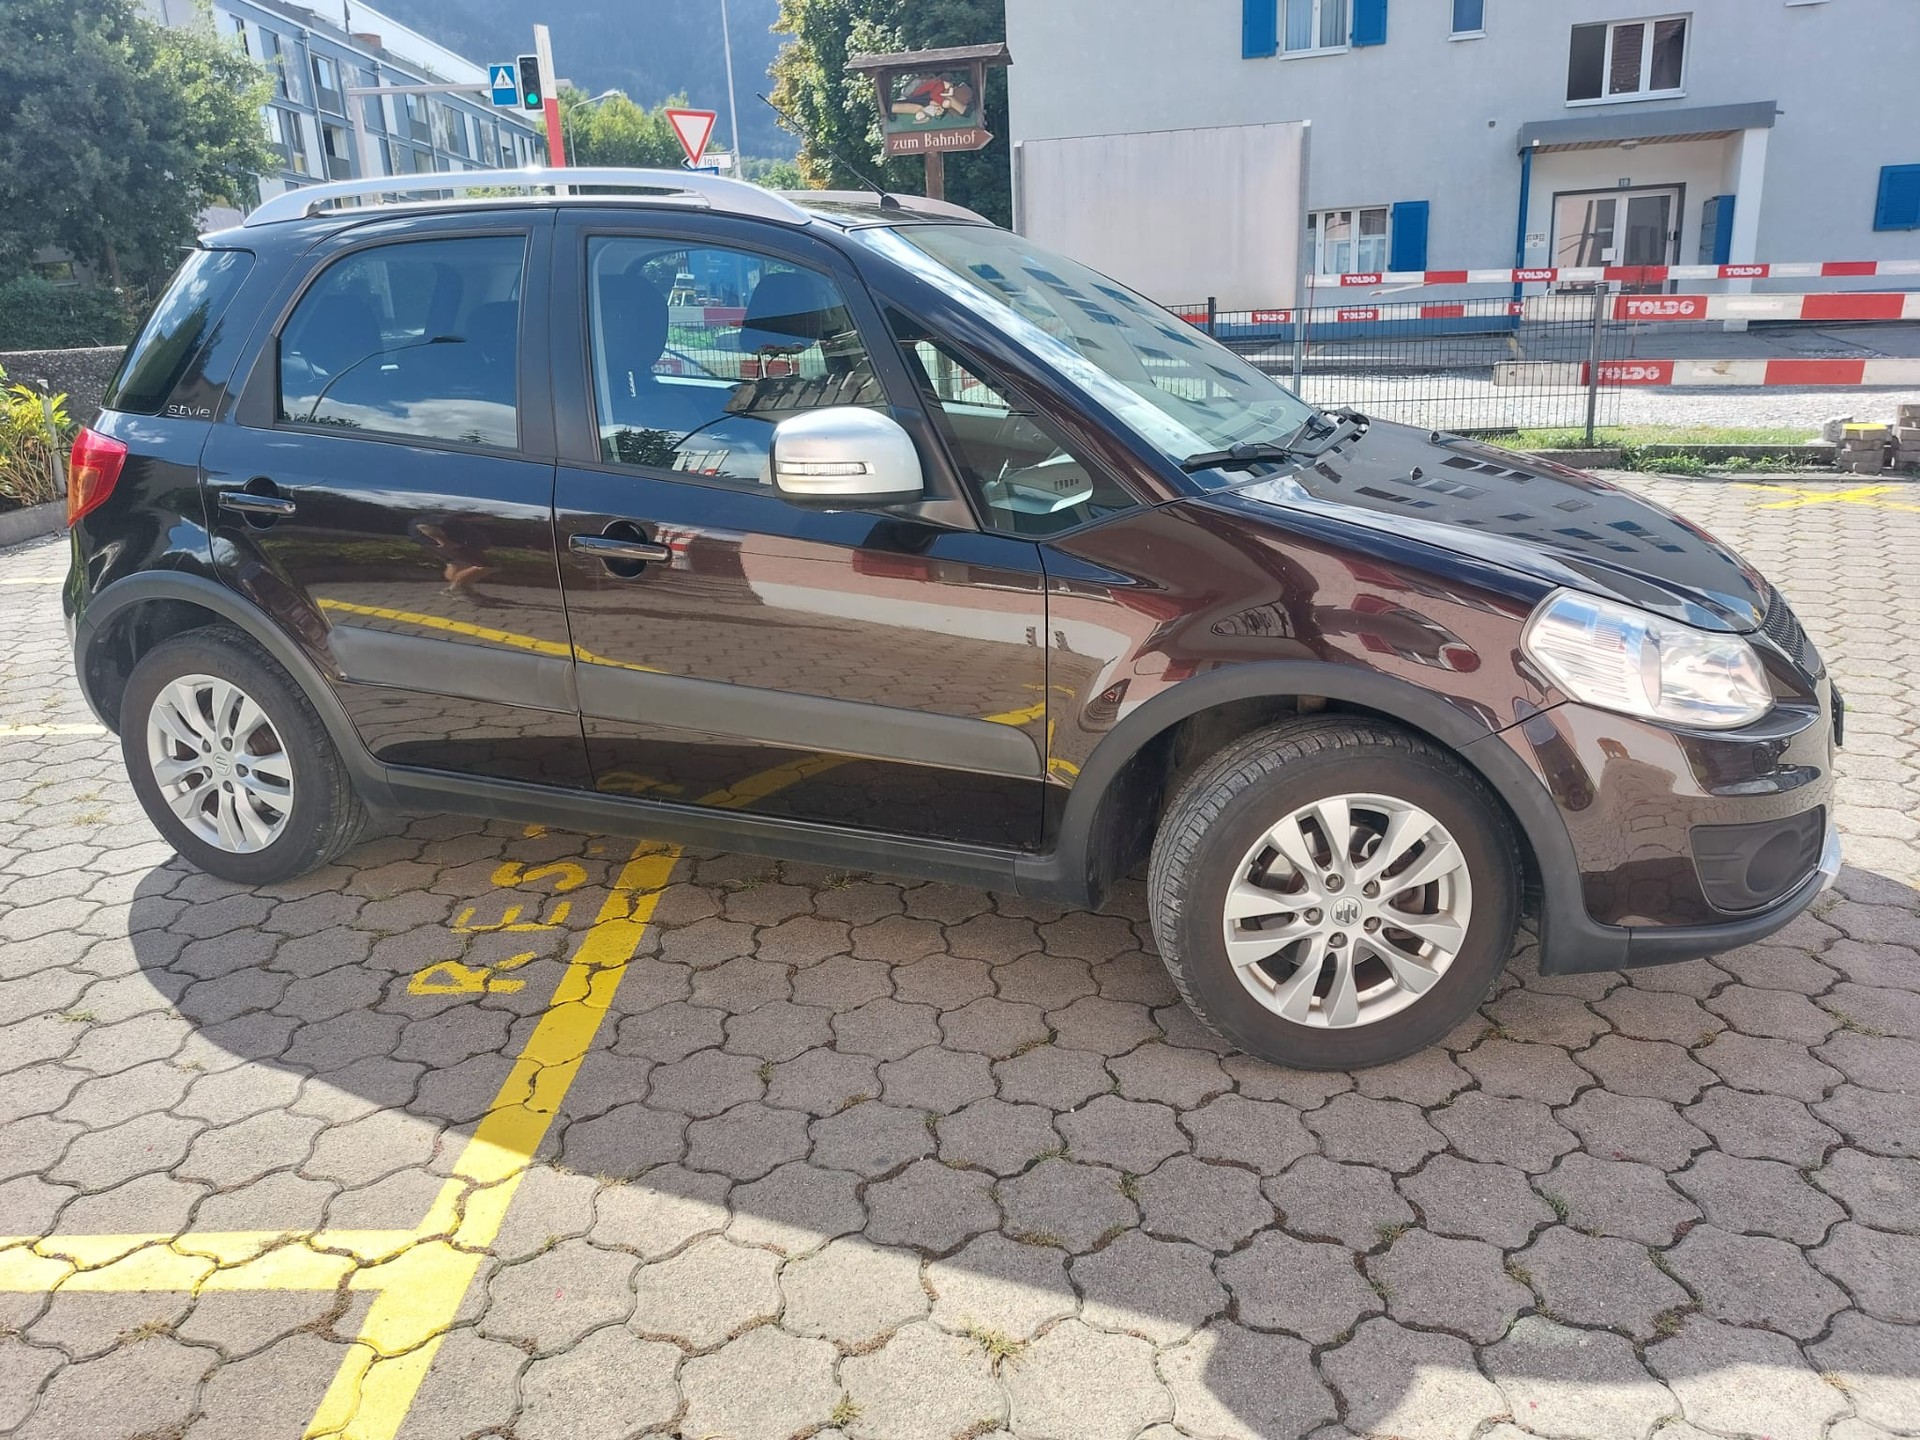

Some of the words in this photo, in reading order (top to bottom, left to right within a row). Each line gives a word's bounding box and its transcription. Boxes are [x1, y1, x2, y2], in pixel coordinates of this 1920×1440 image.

[892, 138, 918, 150] zum
[924, 130, 978, 148] Bahnhof
[1516, 270, 1552, 280] TOLDO
[1725, 267, 1762, 276] TOLDO
[1345, 275, 1377, 284] TOLDO
[1627, 300, 1695, 315] TOLDO
[1341, 311, 1373, 320] TOLDO
[166, 404, 211, 418] style
